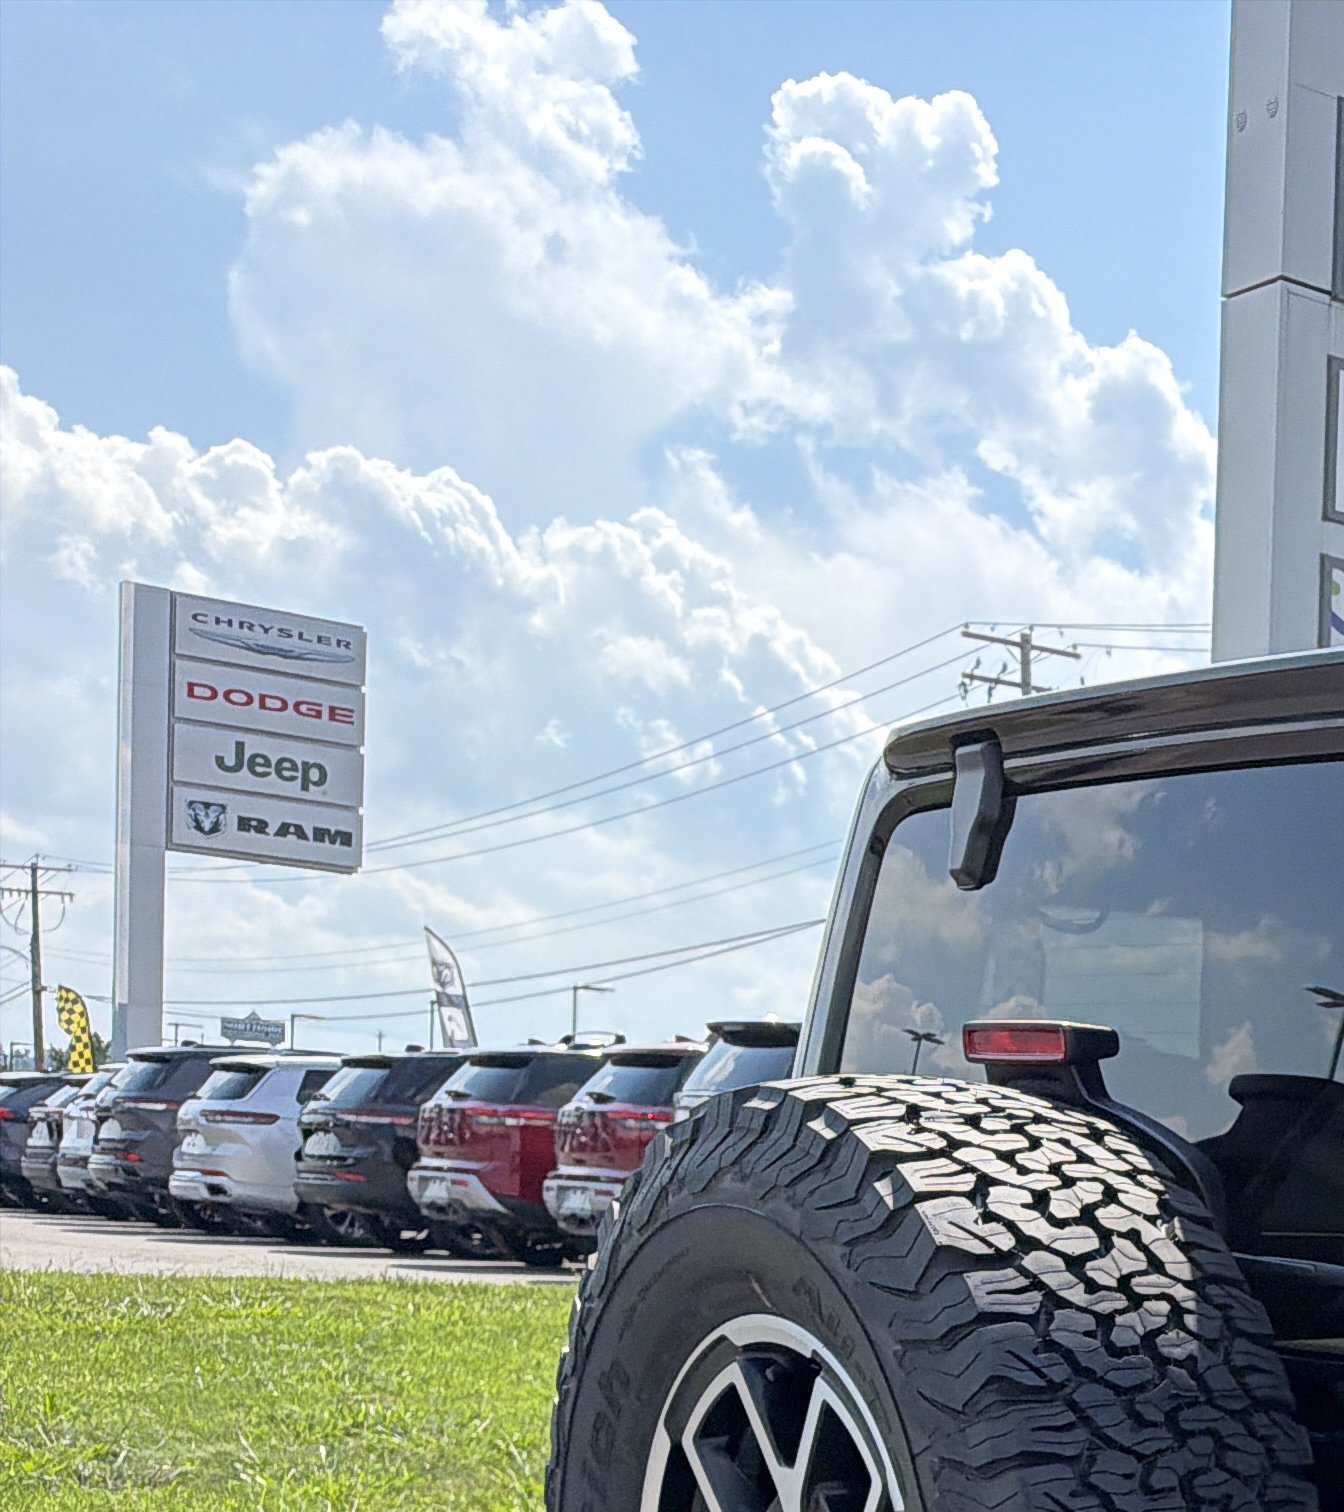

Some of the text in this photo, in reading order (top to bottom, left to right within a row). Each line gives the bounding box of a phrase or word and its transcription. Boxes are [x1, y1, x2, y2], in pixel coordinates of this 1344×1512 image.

[191, 612, 352, 650] CHRYSLER
[186, 681, 355, 726] DODGE
[214, 740, 328, 792] Jeep
[236, 814, 353, 848] RAM
